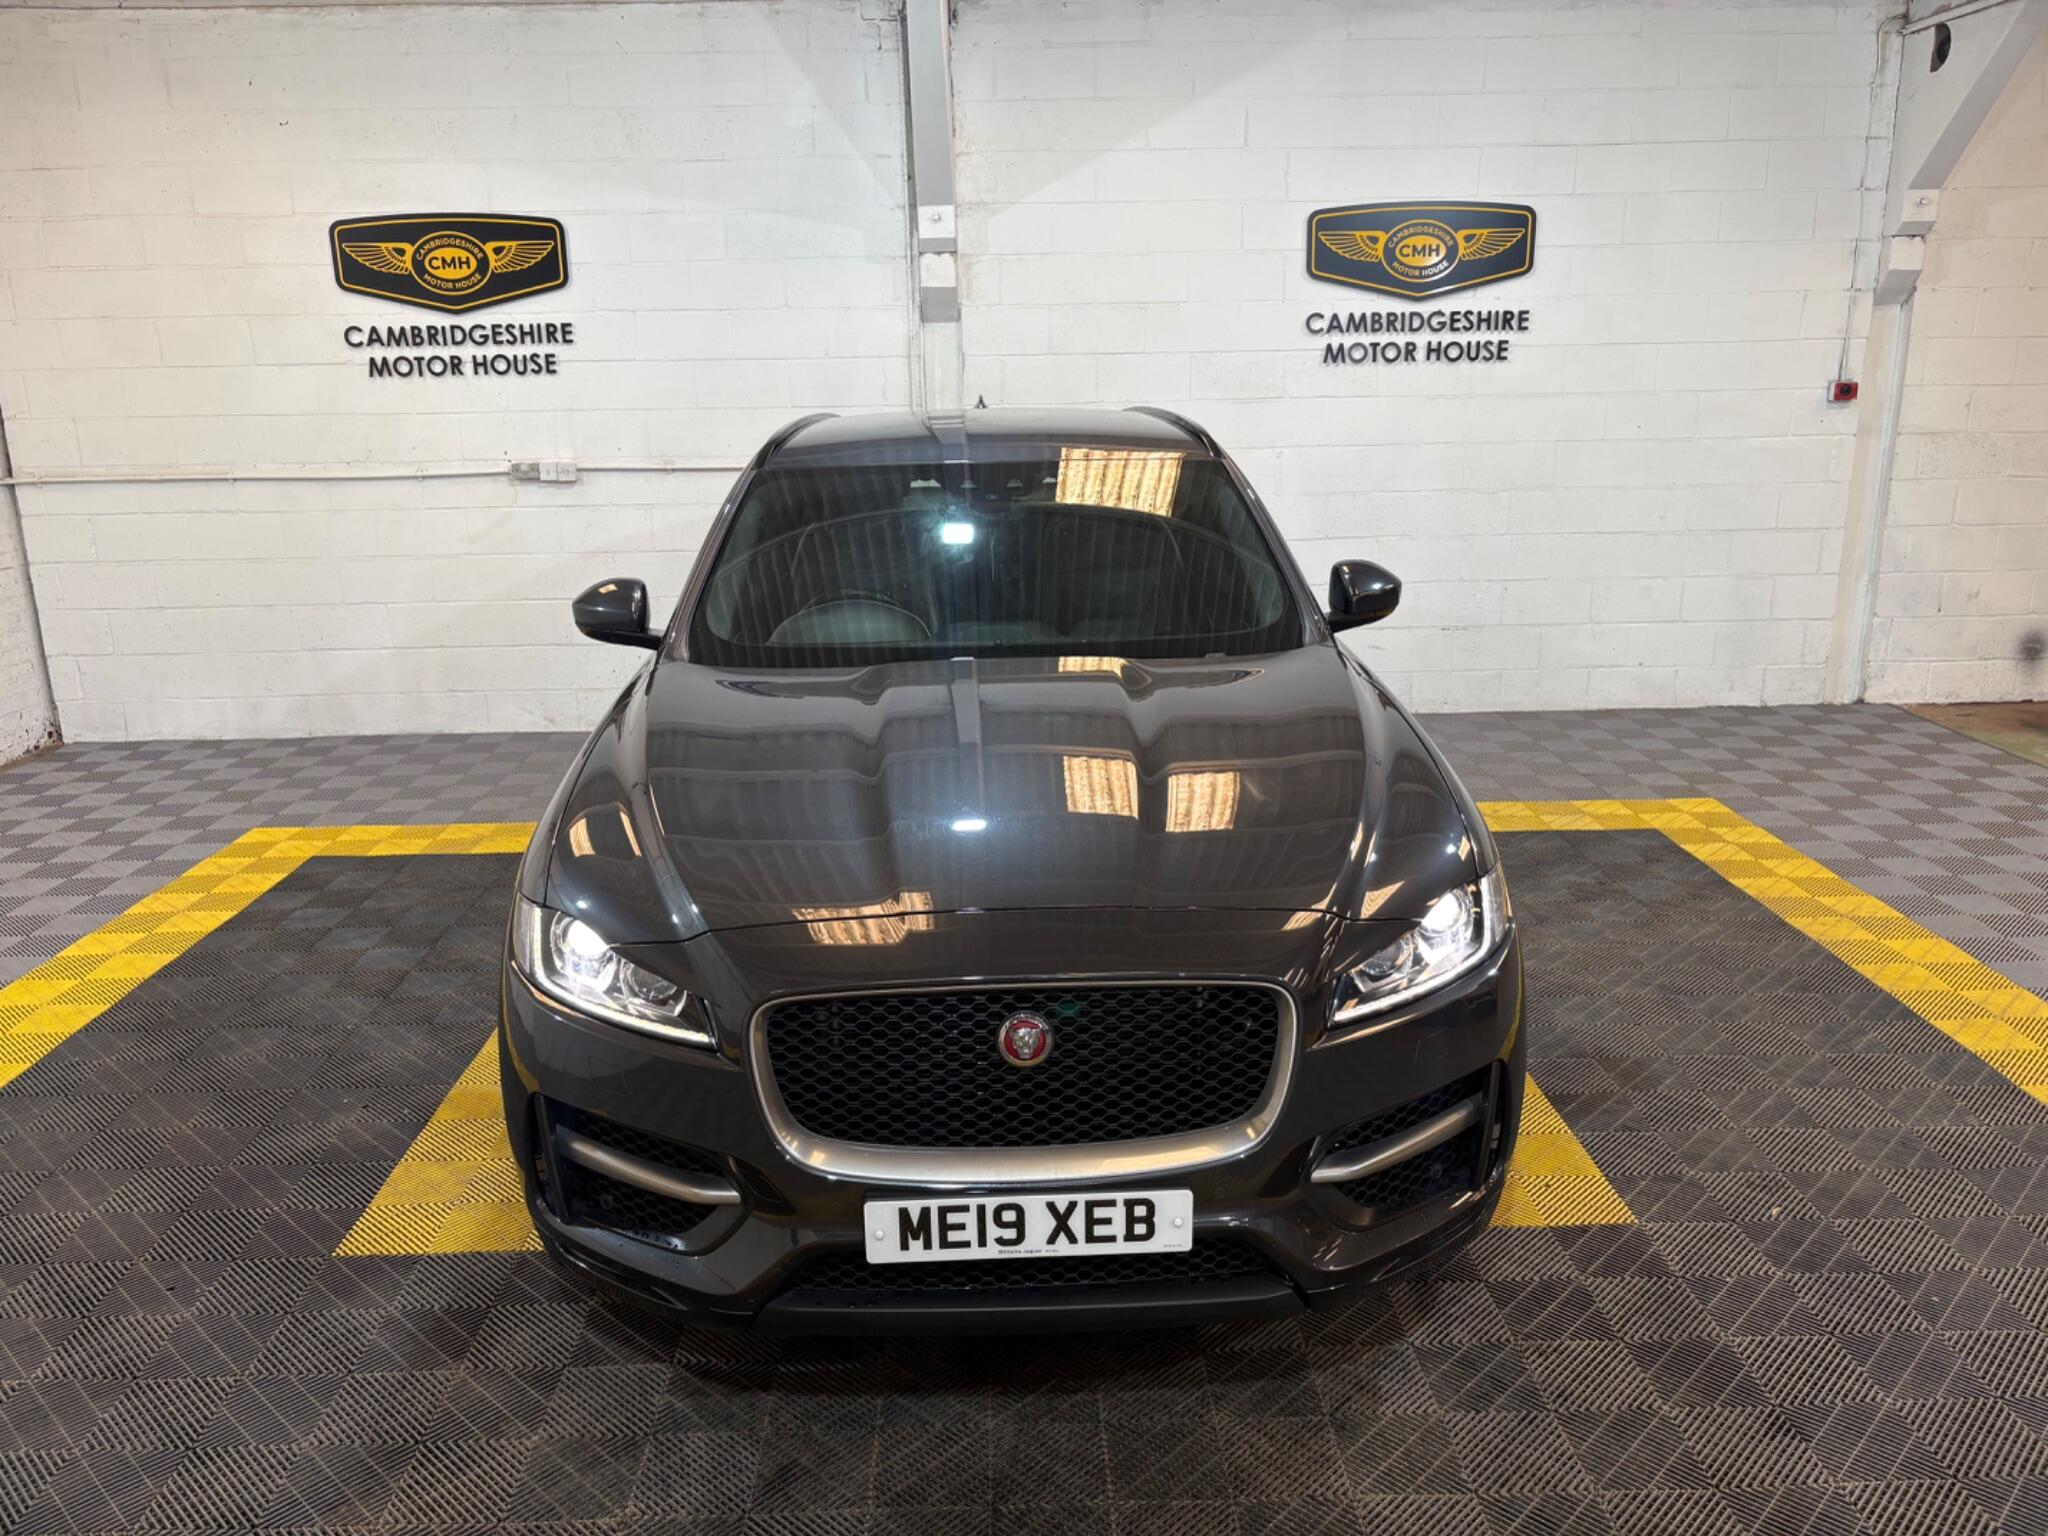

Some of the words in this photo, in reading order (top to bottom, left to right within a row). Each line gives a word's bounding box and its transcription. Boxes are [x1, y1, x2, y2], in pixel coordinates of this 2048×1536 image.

[416, 237, 484, 261] CAMBRIDGESHIRE
[1399, 244, 1440, 258] CMH
[428, 255, 471, 270] CMH
[1392, 261, 1421, 277] MOTOR
[1422, 260, 1449, 276] HOUSE
[423, 273, 454, 289] MOTOR
[455, 273, 481, 289] HOUSE
[1306, 309, 1530, 334] CAMBRIDGESHIRE
[344, 322, 574, 347] CAMBRIDGESHIRE
[1323, 341, 1417, 364] MOTOR
[1426, 340, 1510, 363] HOUSE
[368, 354, 464, 378] MOTOR
[473, 353, 558, 376] HOUSE
[898, 1202, 1026, 1251] ME19
[1045, 1198, 1156, 1245] XEB
